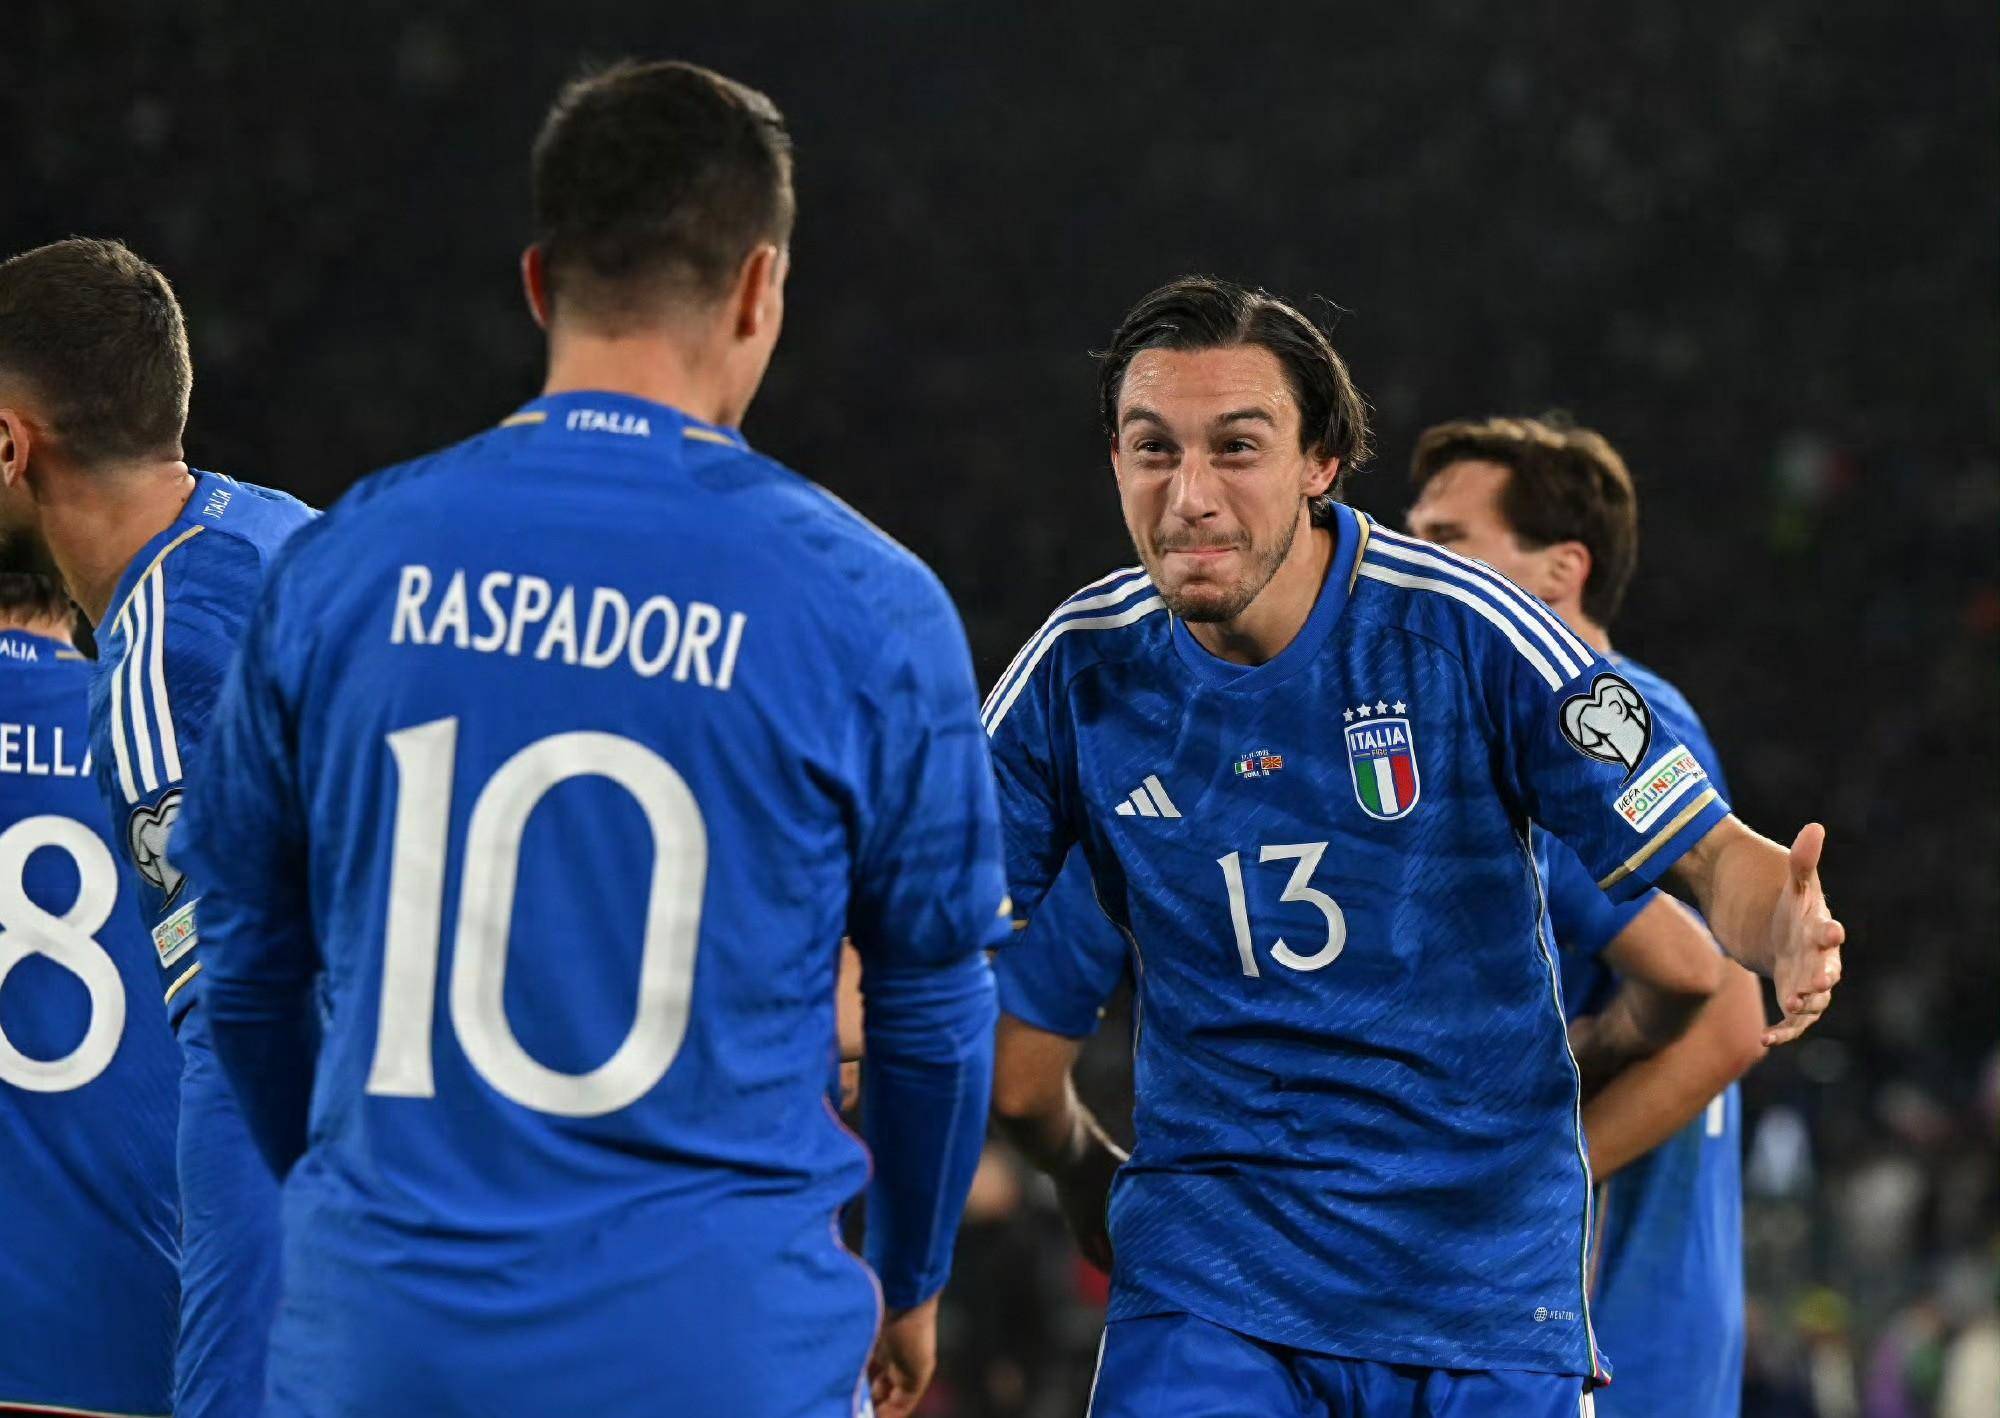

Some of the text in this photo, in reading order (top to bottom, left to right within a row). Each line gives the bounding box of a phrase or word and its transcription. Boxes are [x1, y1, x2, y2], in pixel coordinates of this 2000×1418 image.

[565, 409, 651, 438] ITALIA
[202, 488, 232, 519] ITALIA
[390, 564, 747, 691] RASPADORI
[1350, 726, 1406, 751] ITALIA
[1618, 788, 1641, 811] UEFA
[364, 715, 709, 1118] 10
[1216, 841, 1347, 978] 13
[0, 814, 126, 1093] 8
